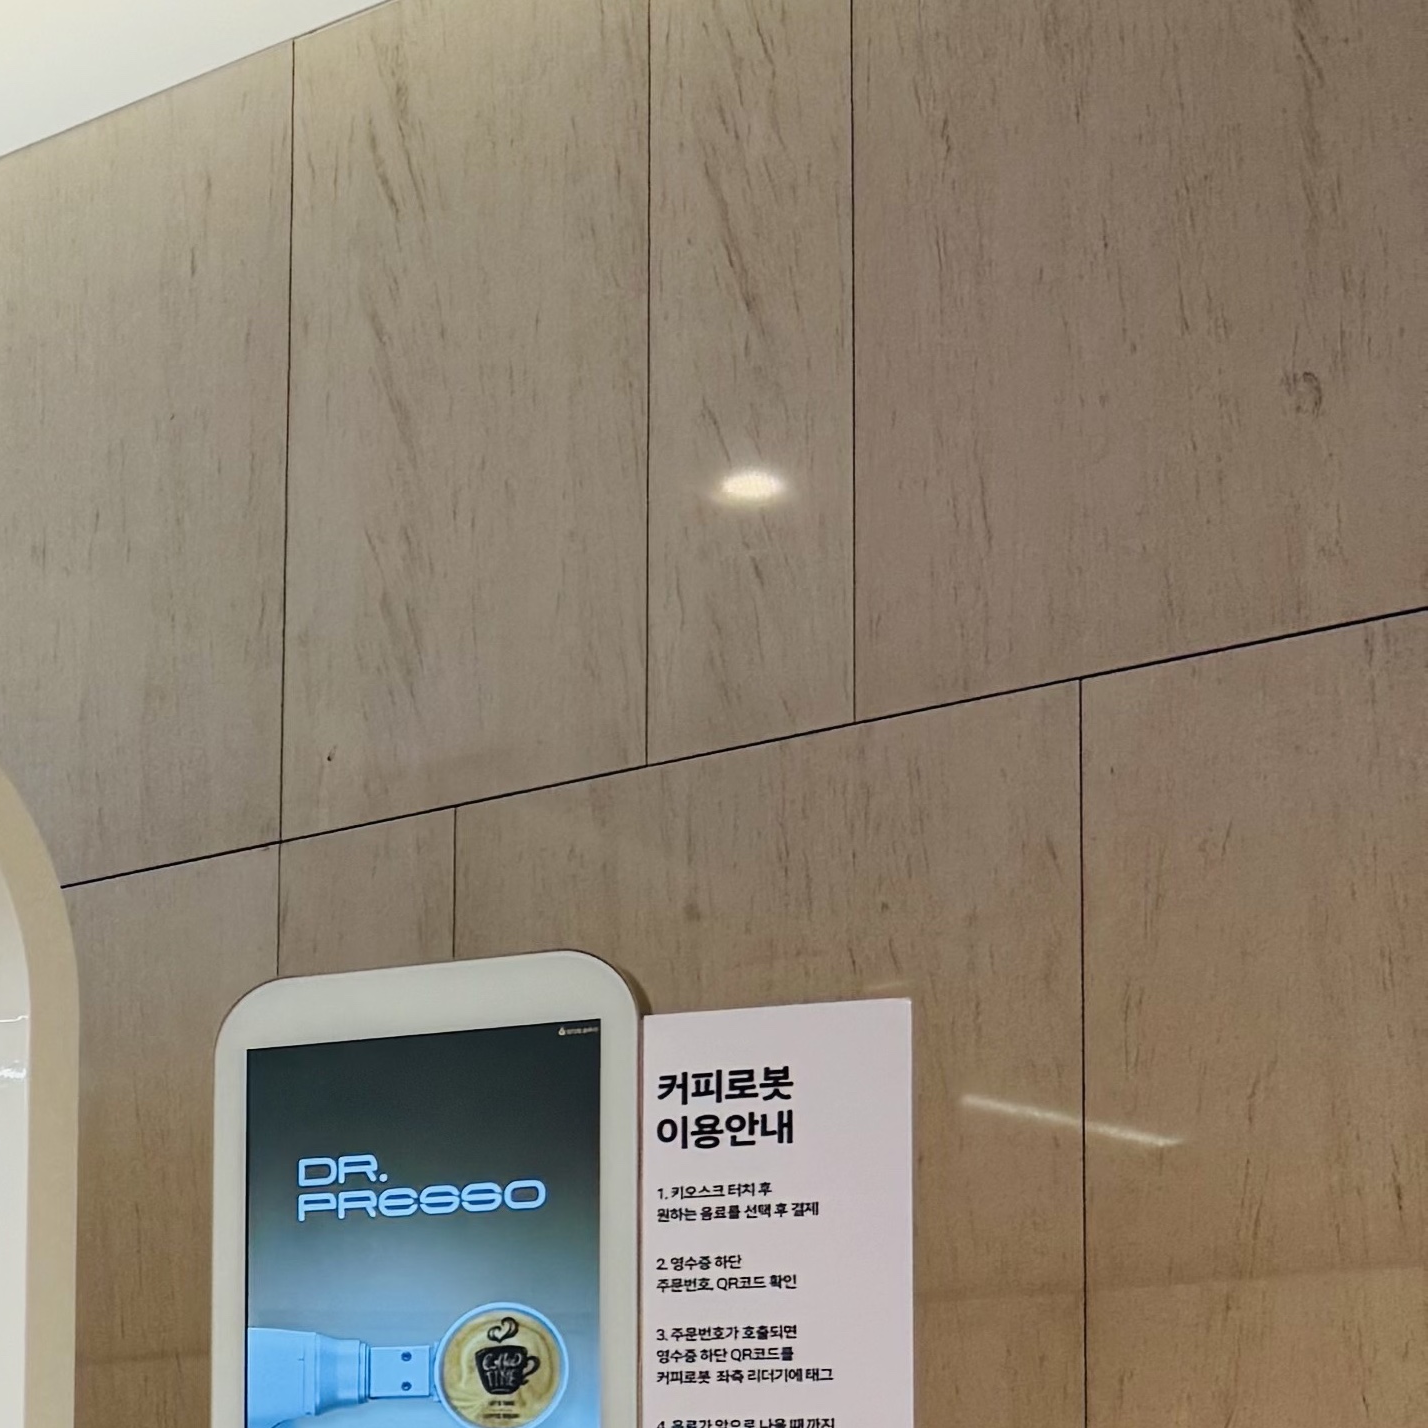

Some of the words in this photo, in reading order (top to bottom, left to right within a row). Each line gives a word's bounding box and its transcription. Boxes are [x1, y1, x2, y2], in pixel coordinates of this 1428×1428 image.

[657, 1066, 794, 1105] 커피로봇
[657, 1109, 793, 1149] 이용안내
[298, 1154, 388, 1187] DR.
[657, 1188, 668, 1199] 1.
[671, 1185, 725, 1200] 키오스크
[728, 1183, 755, 1197] 터치
[758, 1182, 772, 1196] 후
[298, 1179, 546, 1222] PRESSO
[657, 1208, 697, 1222] 원하는
[700, 1205, 741, 1221] 음료를
[744, 1204, 771, 1218] 선택
[774, 1203, 788, 1217] 후
[791, 1201, 819, 1217] 결제
[671, 1256, 712, 1271] 영수증
[714, 1254, 742, 1269] 하단
[717, 1276, 767, 1291] QR코드
[769, 1274, 797, 1289] 확인
[656, 1329, 668, 1341] 3.
[671, 1326, 739, 1342] 주문번호가
[742, 1325, 797, 1340] 호출되면
[657, 1349, 697, 1364] 영수증
[700, 1348, 728, 1362] 하단
[731, 1347, 794, 1362] QR코드를
[657, 1370, 711, 1385] 커피로봇
[717, 1370, 744, 1383] 좌측
[748, 1368, 803, 1383] 리더기에
[805, 1368, 834, 1381] 태그
